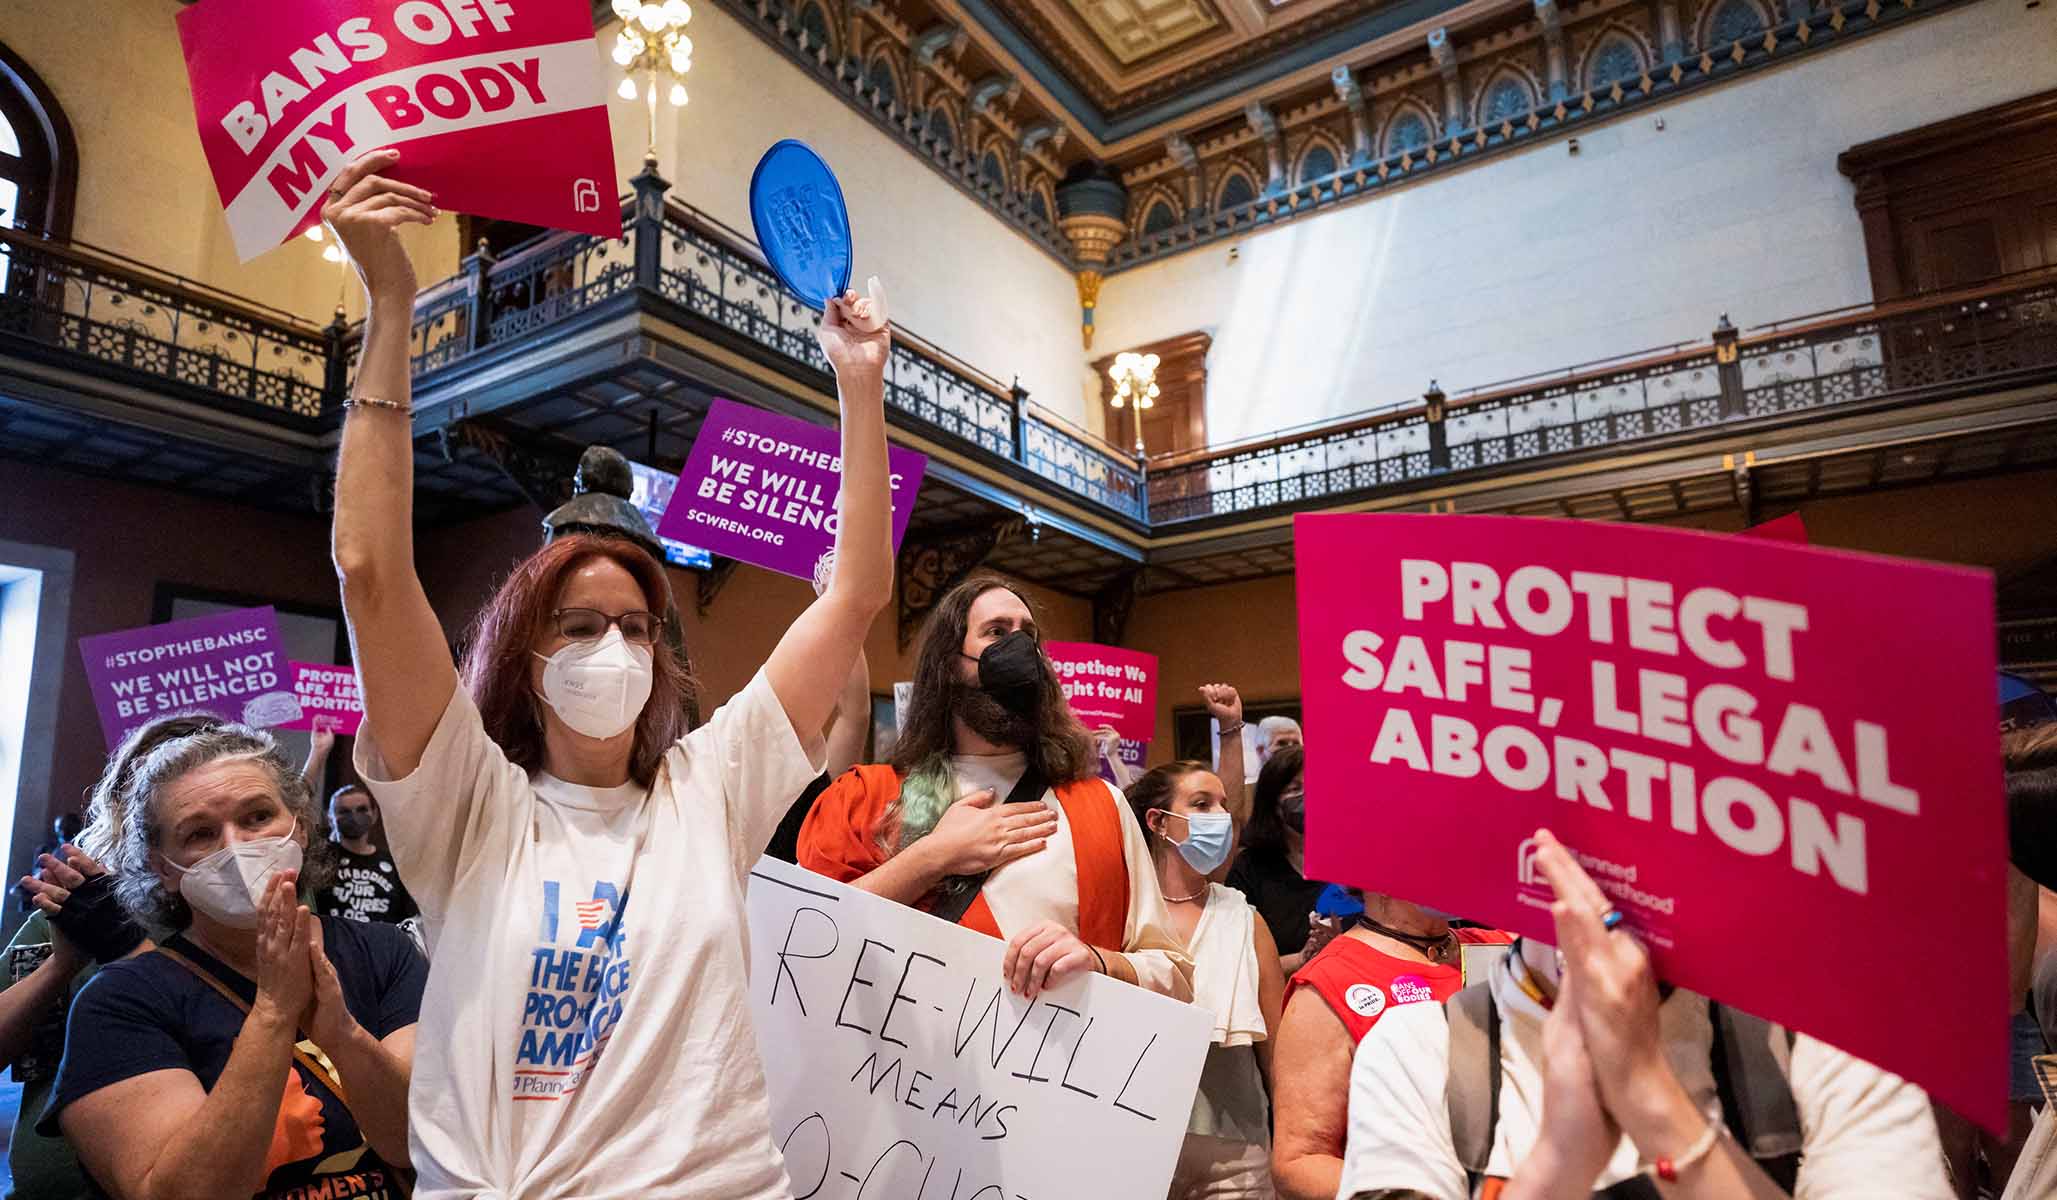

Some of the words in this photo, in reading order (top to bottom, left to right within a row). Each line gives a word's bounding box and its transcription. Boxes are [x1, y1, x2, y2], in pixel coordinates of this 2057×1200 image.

[221, 17, 387, 156] BANS
[394, 0, 515, 45] OFF
[267, 102, 355, 211] MY
[366, 58, 547, 131] BODY
[710, 455, 754, 485] WE
[761, 470, 824, 506] WILL
[721, 427, 904, 490] #STOPTHEBC
[687, 509, 784, 546] SCWREN.ORG
[697, 477, 737, 505] BE
[740, 490, 841, 536] SILENC
[1400, 559, 1808, 681] PROTECT
[105, 628, 267, 668] #STOPTHEBANSC
[1051, 658, 1122, 677] ogether
[1124, 664, 1147, 683] We
[111, 679, 152, 698] WE
[157, 663, 219, 689] WILL
[223, 652, 275, 675] NOT
[116, 698, 149, 718] BE
[155, 672, 278, 710] SILENCED
[294, 681, 329, 697] AFE,
[1061, 679, 1094, 700] ght
[1097, 681, 1122, 699] for
[1123, 687, 1143, 704] All
[300, 695, 362, 712] BORTIO
[1342, 630, 1564, 727] SAFE,
[1591, 661, 1920, 816] LEGAL
[1370, 708, 1869, 895] ABORTION
[532, 948, 583, 992] THE
[751, 872, 1157, 1121] REE-WILL
[851, 1052, 1018, 1140] MEANS
